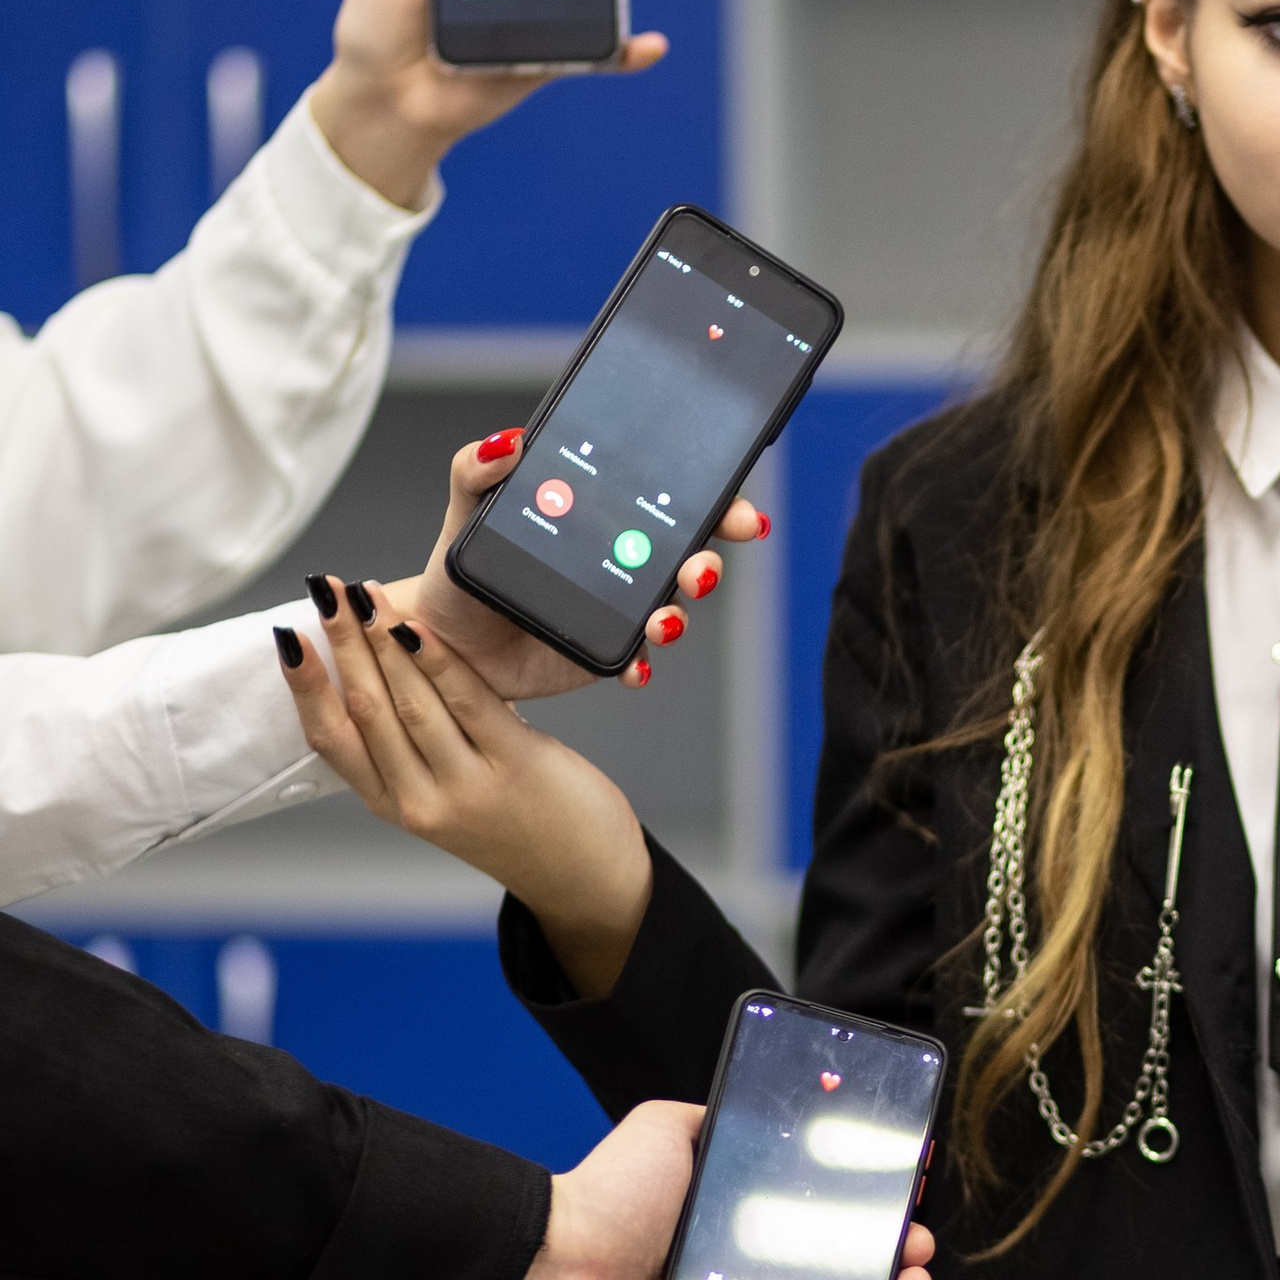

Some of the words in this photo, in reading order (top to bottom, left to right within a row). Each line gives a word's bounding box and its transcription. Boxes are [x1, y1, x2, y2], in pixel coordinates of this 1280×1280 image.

[558, 445, 598, 476] Напомнить
[521, 506, 559, 536] Отклонить
[635, 496, 677, 527] Сообщение
[601, 558, 634, 585] Ответить
